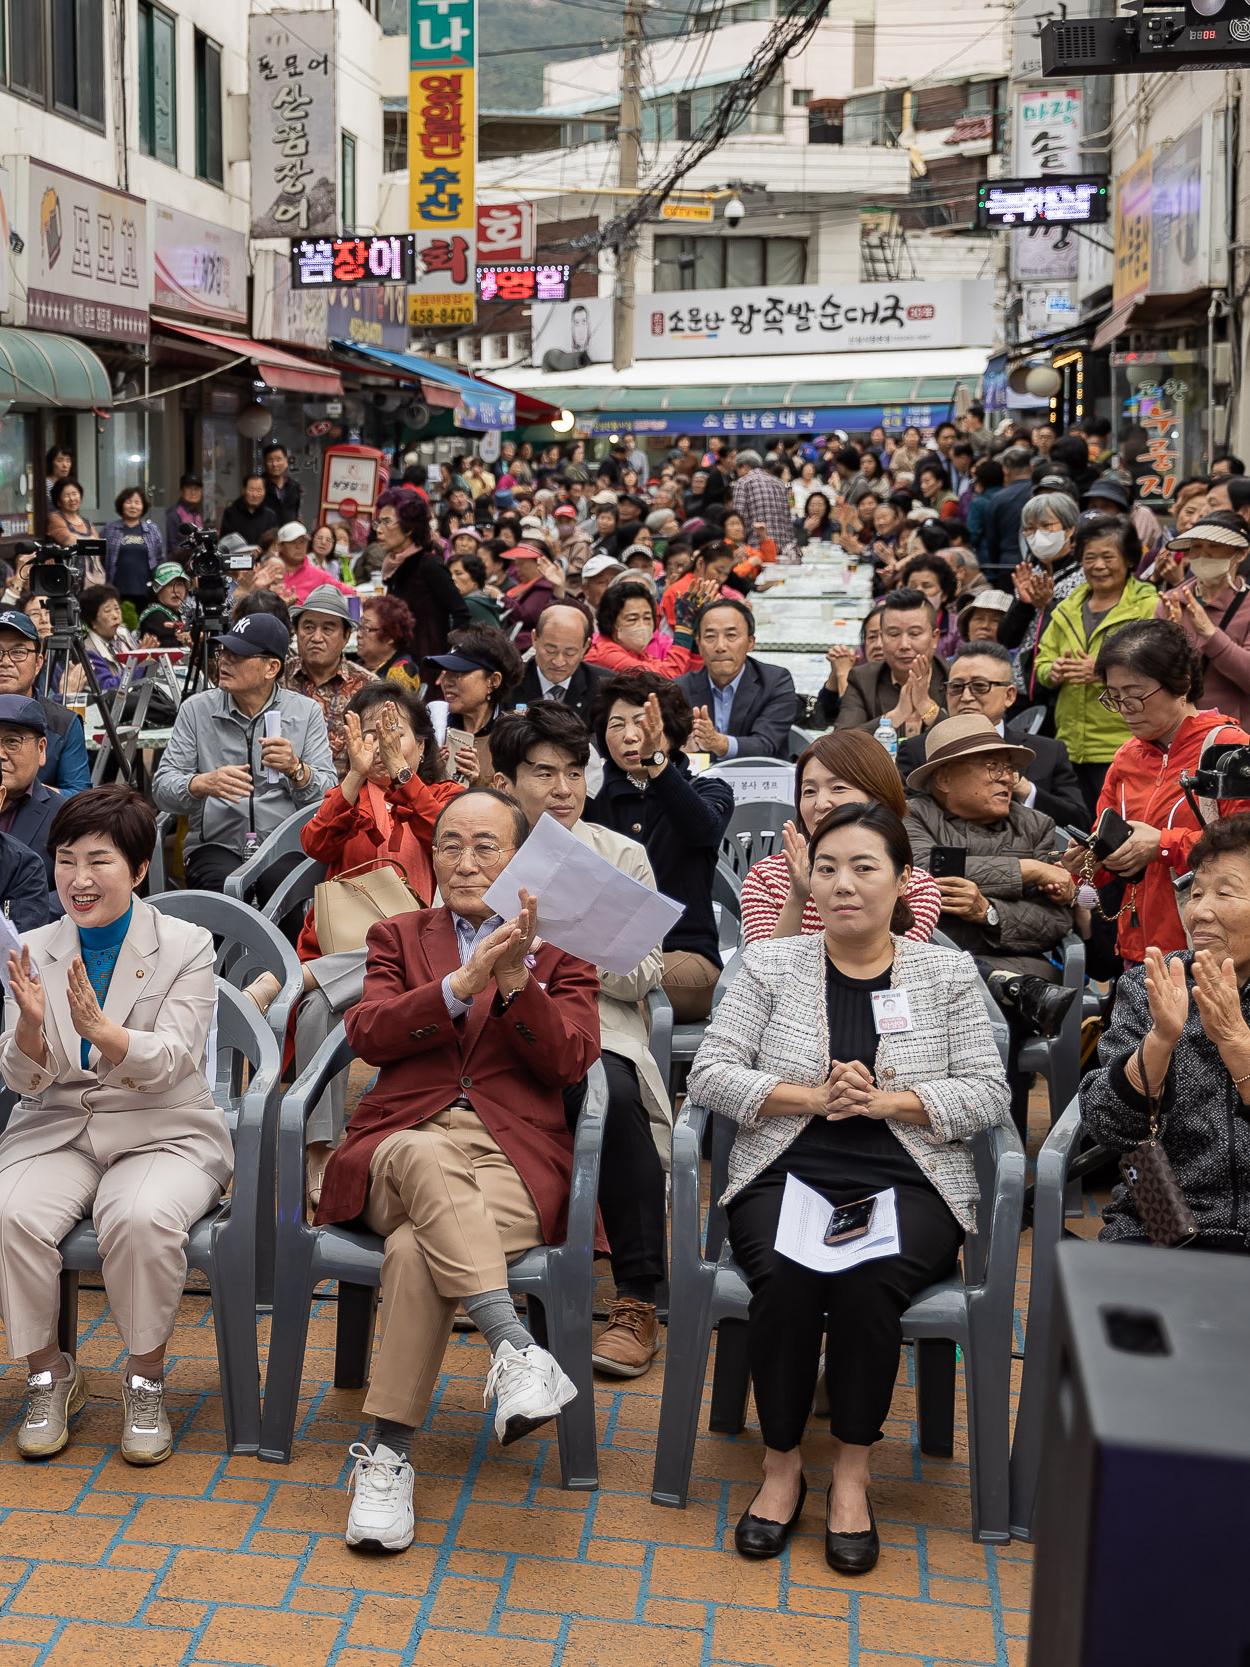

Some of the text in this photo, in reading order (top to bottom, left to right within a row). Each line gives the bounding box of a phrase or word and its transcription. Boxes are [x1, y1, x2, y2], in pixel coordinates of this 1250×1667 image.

[271, 82, 314, 230] 산꼼장어
[417, 166, 464, 222] 수산
[478, 206, 529, 261] 회
[411, 306, 472, 325] 458-8470
[669, 305, 725, 333] 소문난
[1135, 404, 1182, 500] 누룽지
[740, 781, 757, 790] 봉사
[762, 781, 779, 790] 캠프
